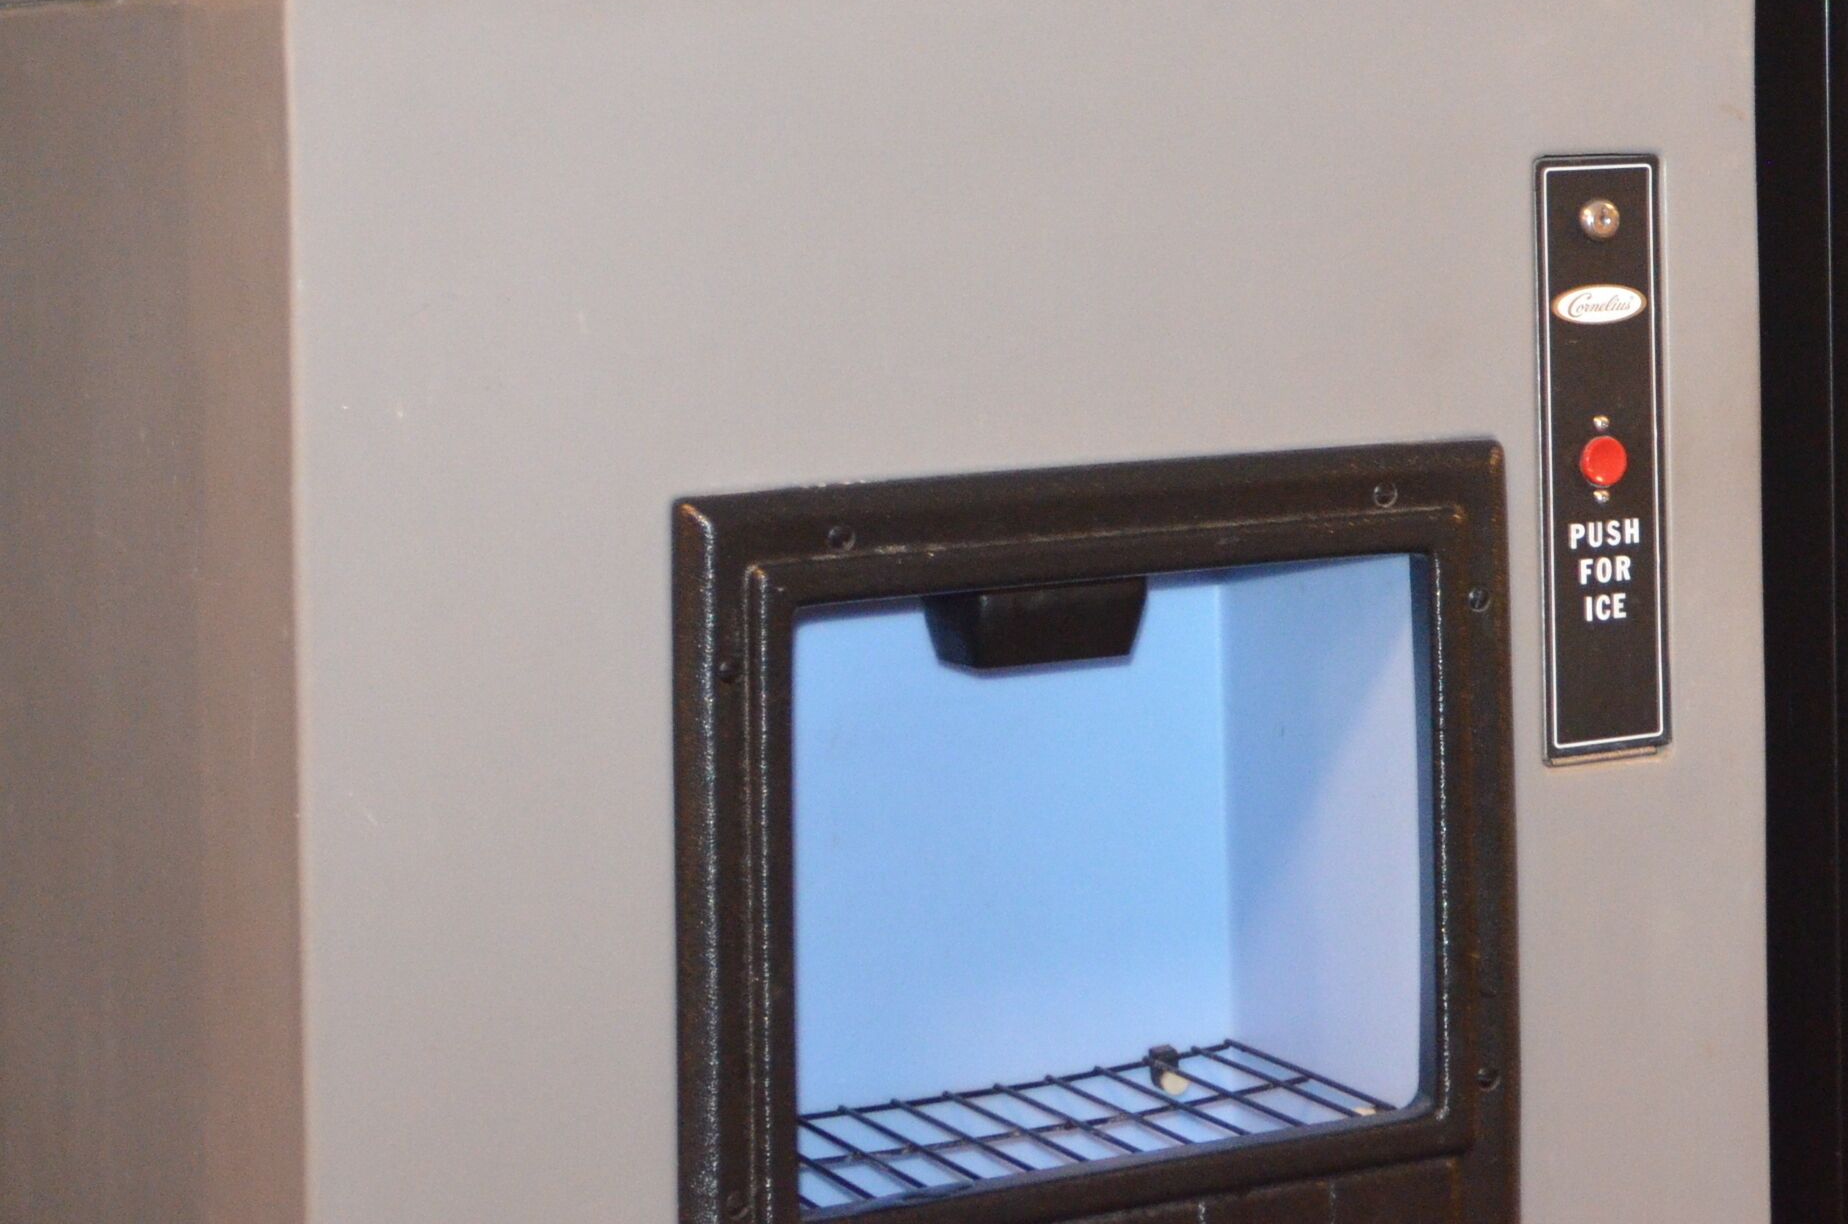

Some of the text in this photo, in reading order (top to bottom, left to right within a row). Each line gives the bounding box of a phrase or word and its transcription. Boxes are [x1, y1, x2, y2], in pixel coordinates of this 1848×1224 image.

[1568, 292, 1632, 318] Cornelius
[1569, 517, 1641, 550] PUSH
[1580, 555, 1632, 585] FOR
[1585, 592, 1628, 623] ICE
